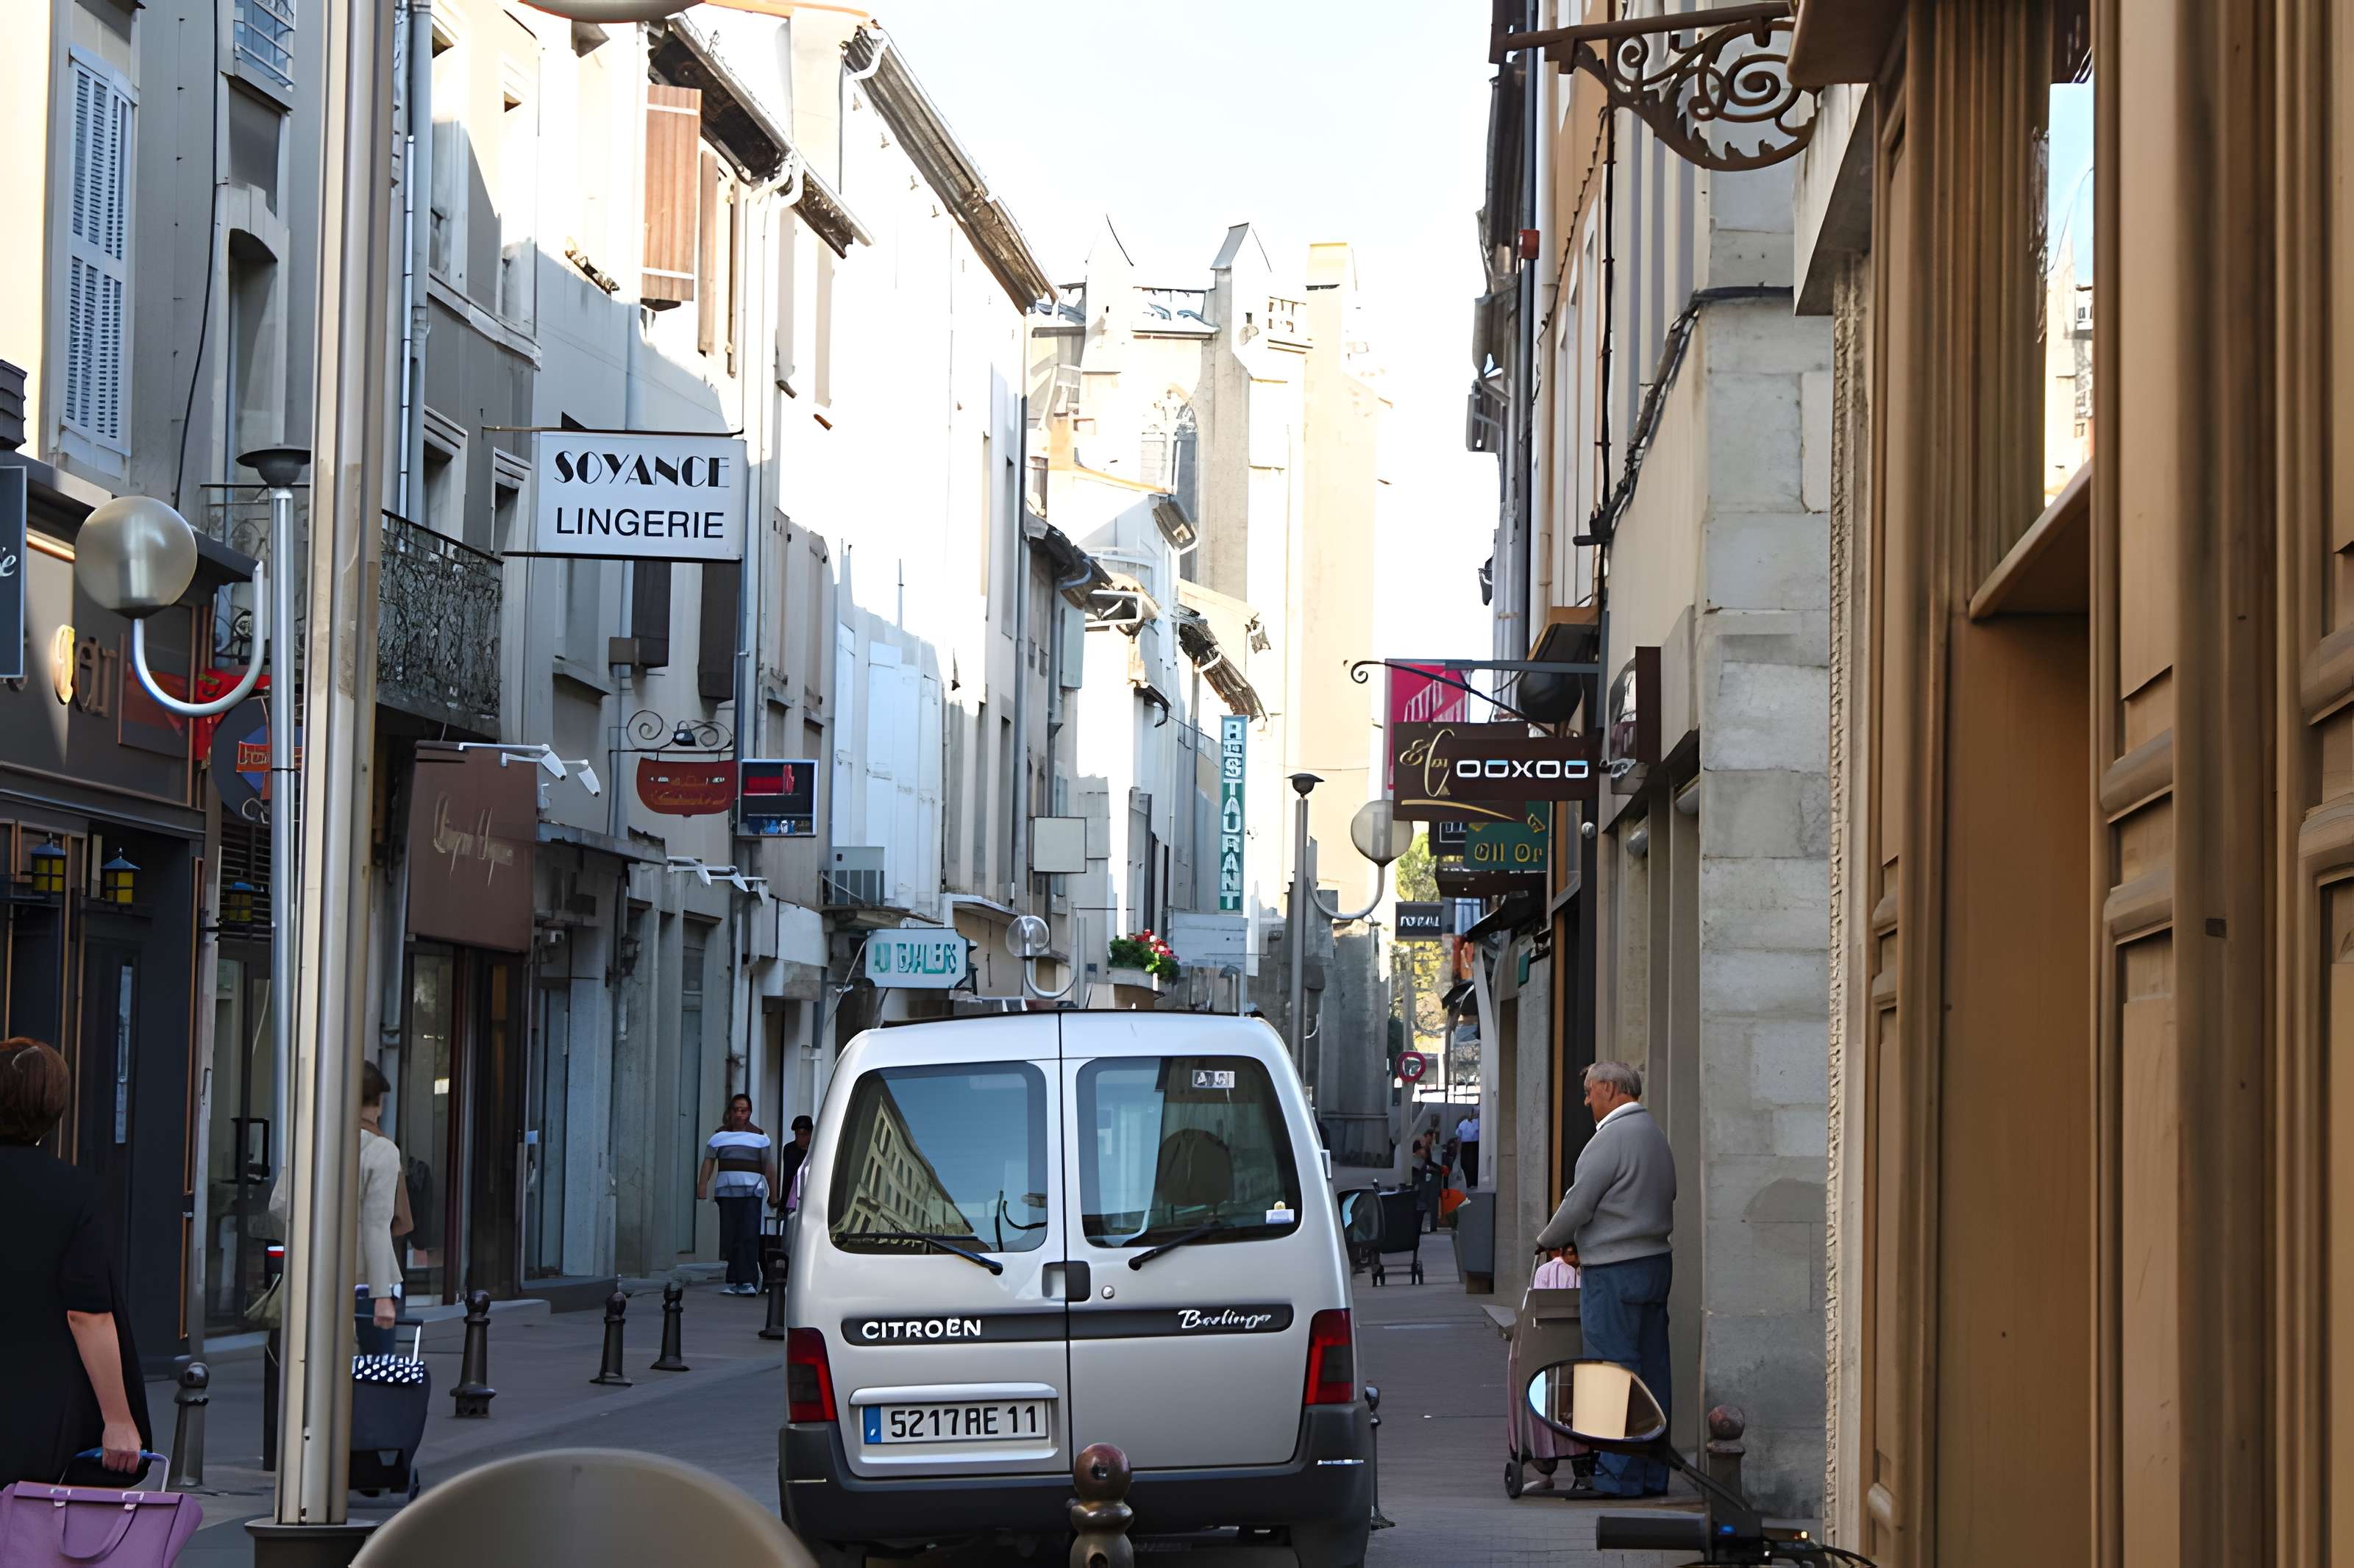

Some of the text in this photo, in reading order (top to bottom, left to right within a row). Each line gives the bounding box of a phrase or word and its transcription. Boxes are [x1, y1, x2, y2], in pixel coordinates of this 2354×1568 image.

[554, 451, 730, 488] SOYANCE
[557, 507, 725, 538] LINGERIE
[890, 1408, 959, 1439] 5217
[1006, 1405, 1036, 1433] 11
